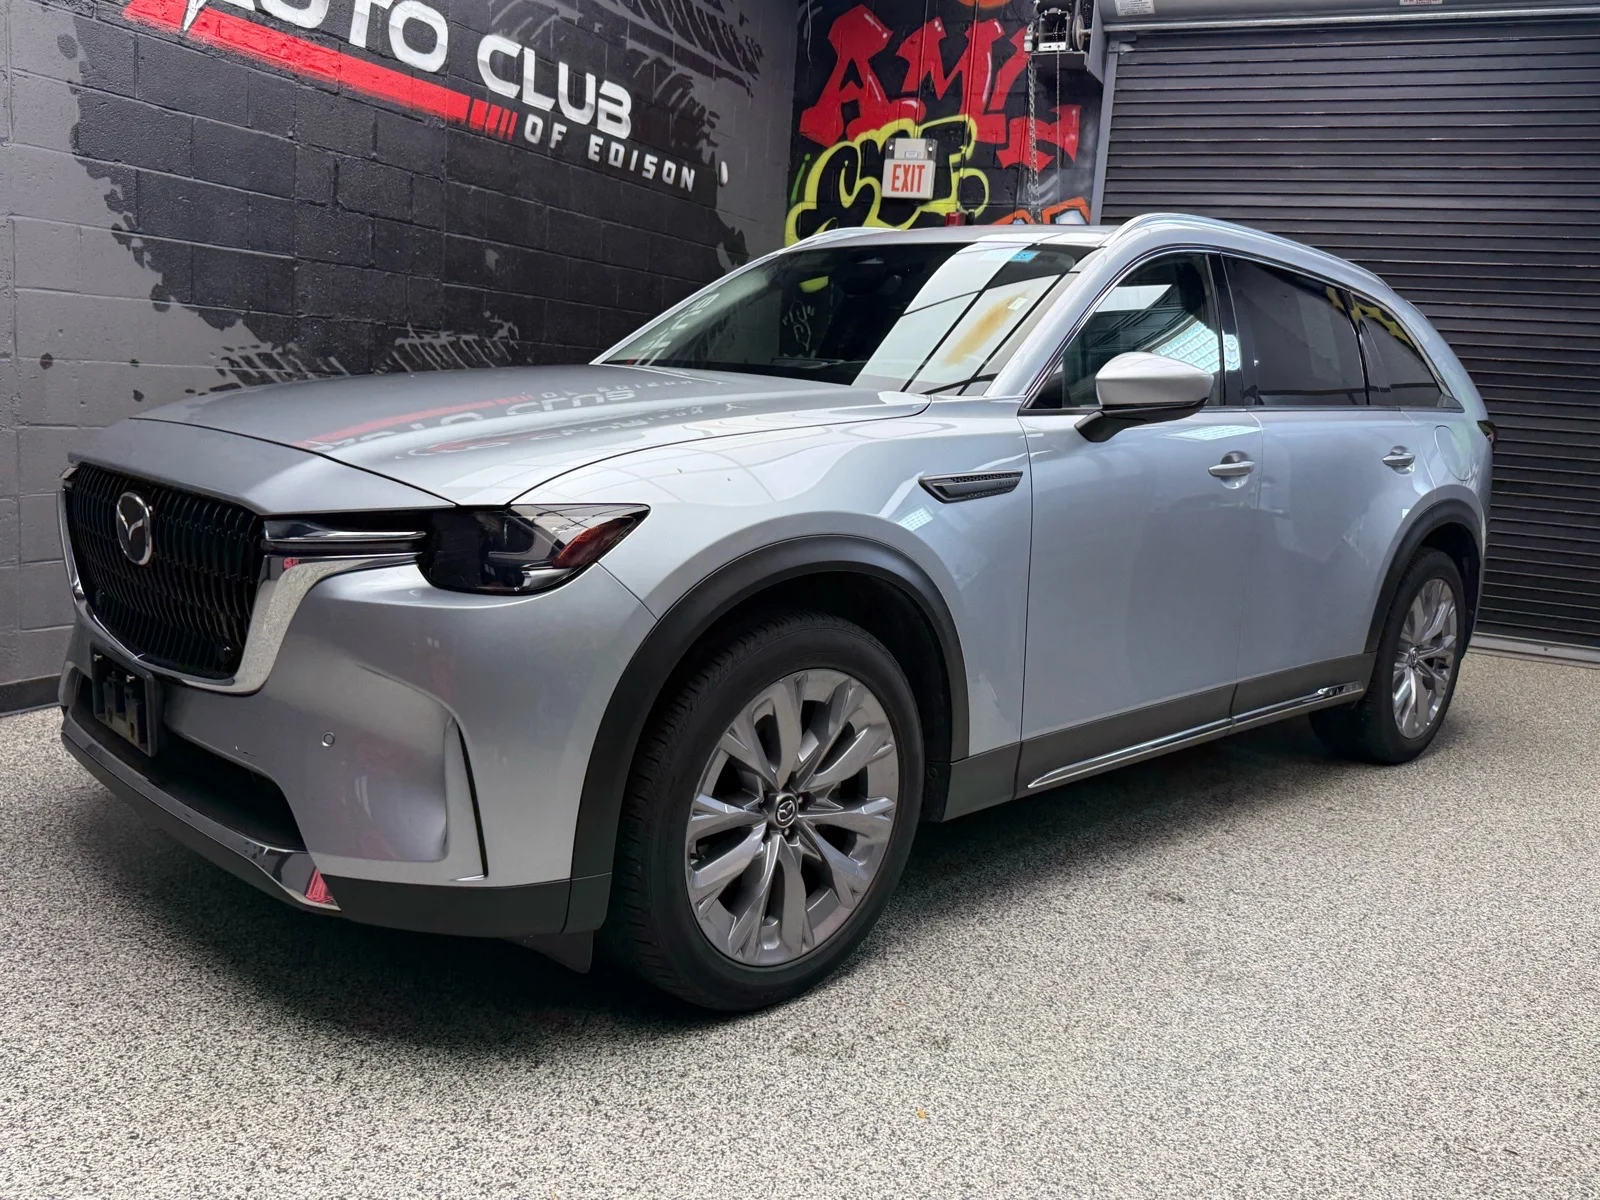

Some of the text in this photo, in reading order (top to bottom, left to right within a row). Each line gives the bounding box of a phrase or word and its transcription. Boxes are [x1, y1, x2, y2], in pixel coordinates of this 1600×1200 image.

[182, 0, 632, 140] TO CLUB
[524, 114, 696, 193] OF EDISON
[891, 164, 926, 193] EXIT
